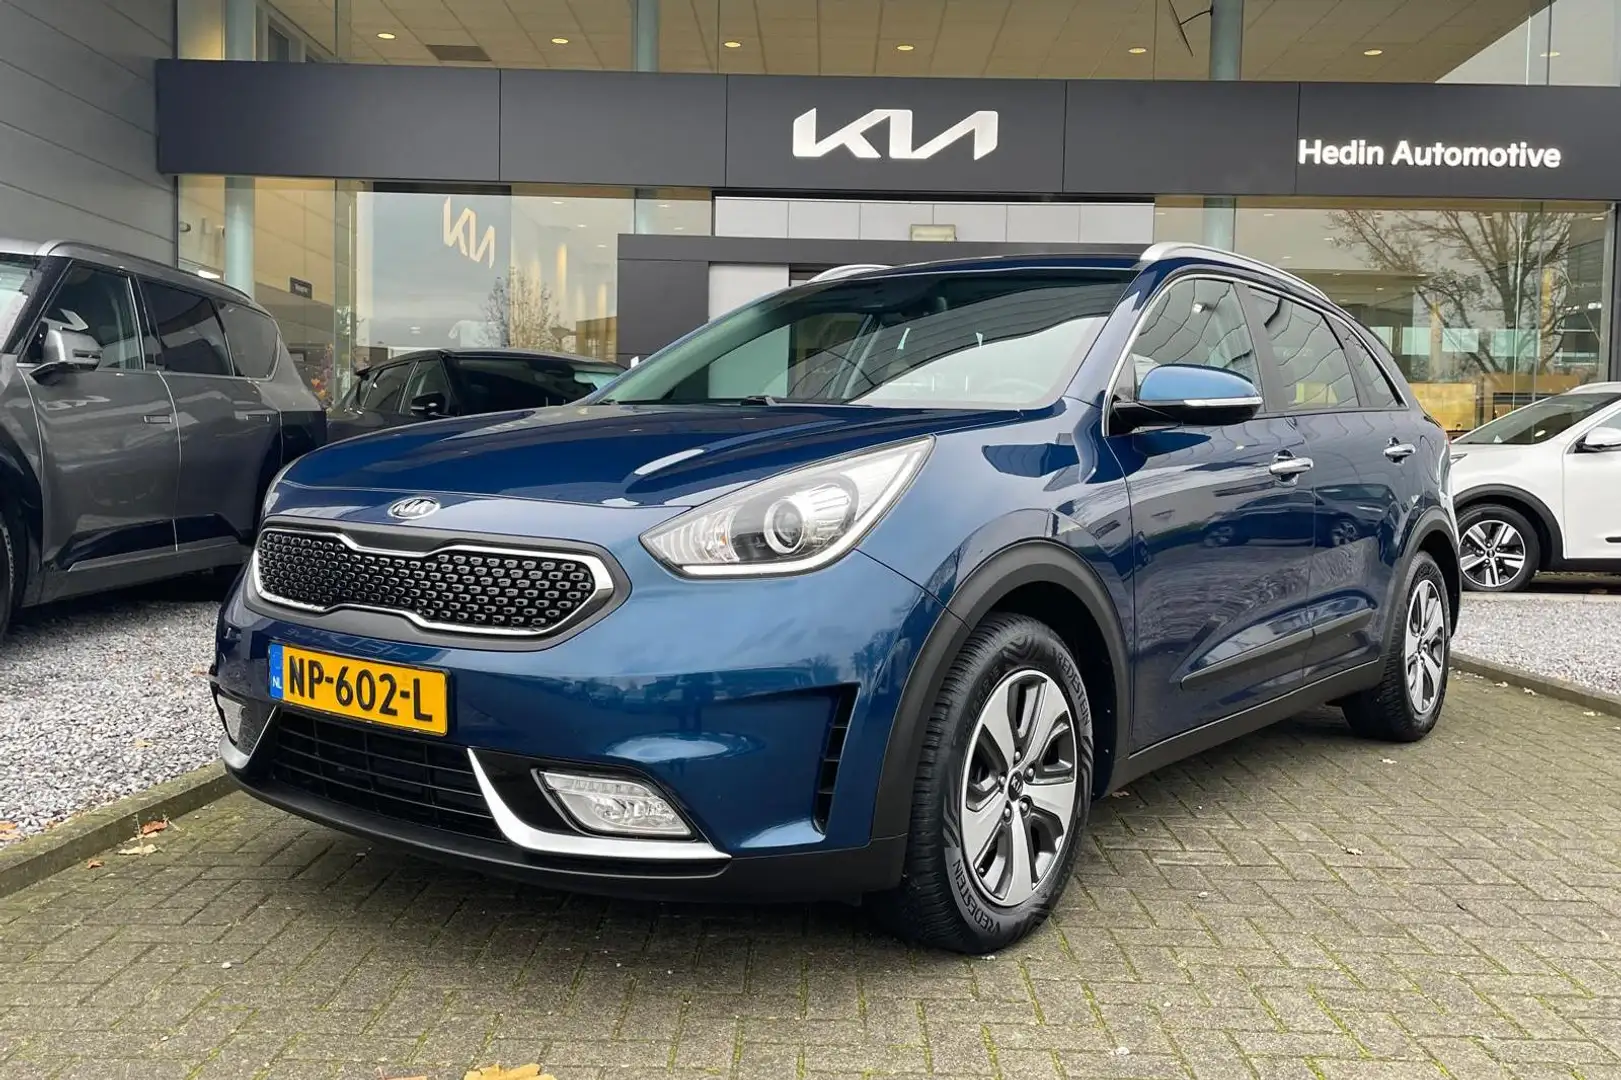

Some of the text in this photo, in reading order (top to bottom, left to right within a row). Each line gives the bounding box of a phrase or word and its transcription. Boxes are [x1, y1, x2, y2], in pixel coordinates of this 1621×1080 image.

[1298, 139, 1562, 168] Hedin Automotive
[272, 676, 283, 691] NL
[289, 655, 433, 722] NP-602-L
[952, 859, 1001, 936] VREDESTEIN
